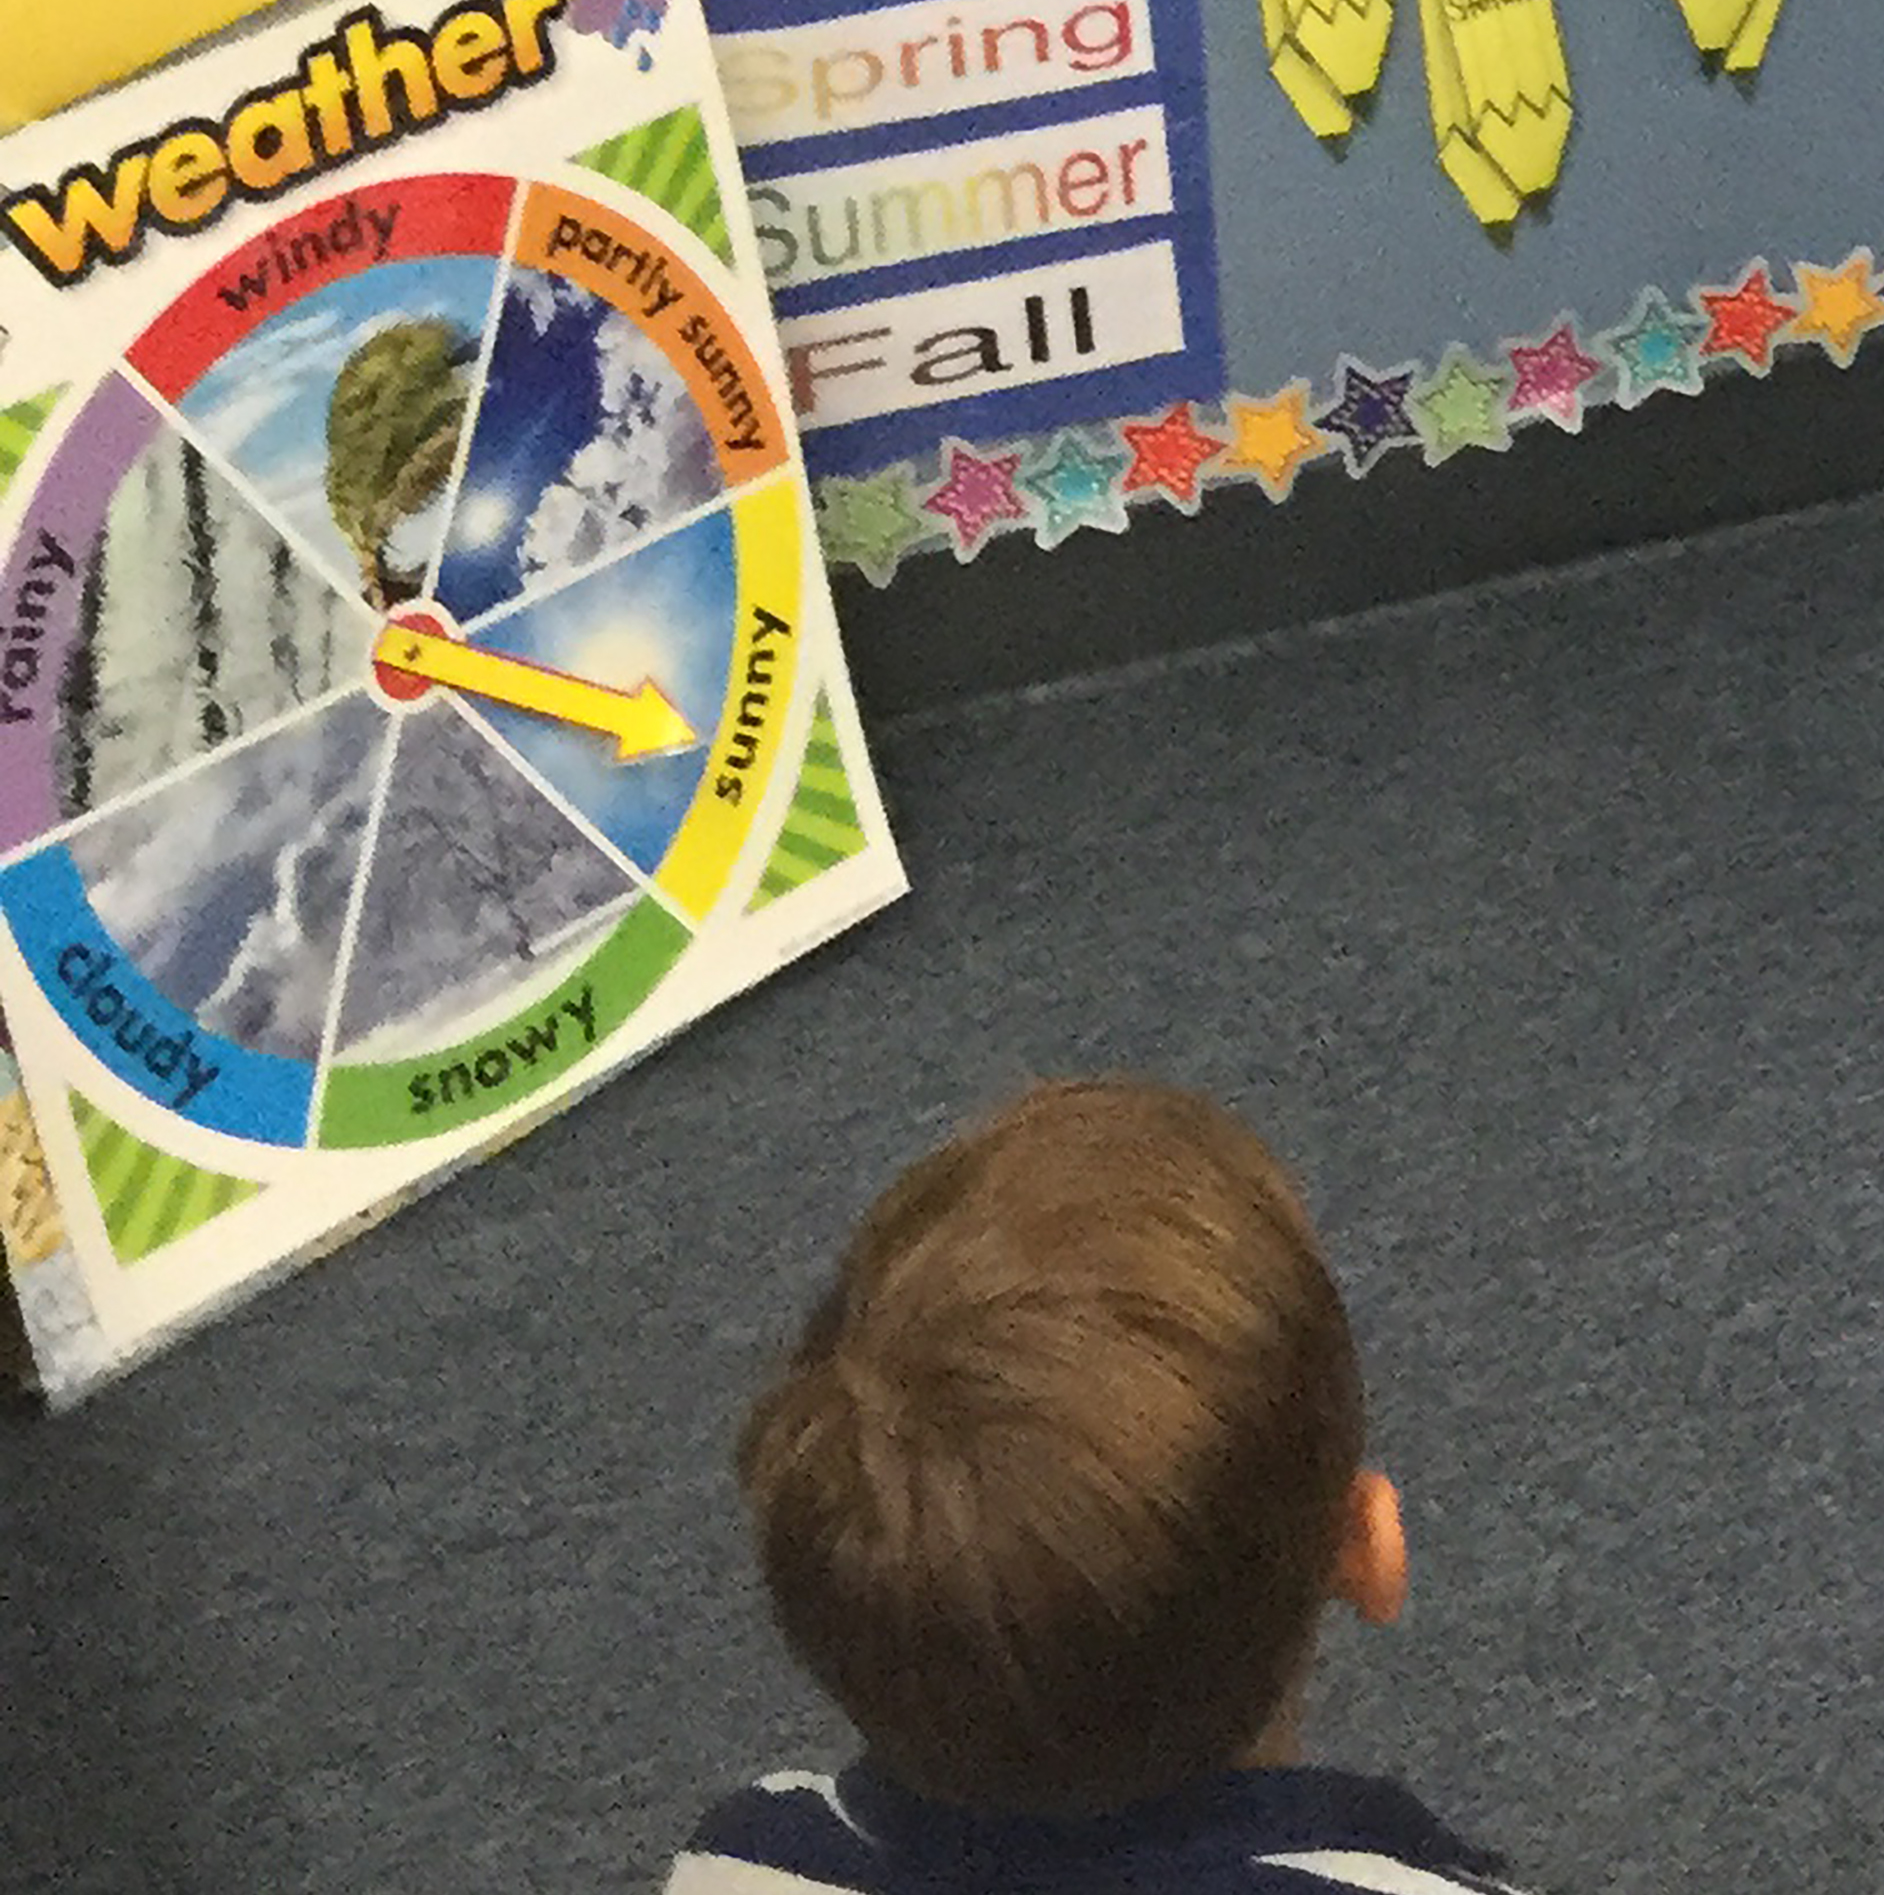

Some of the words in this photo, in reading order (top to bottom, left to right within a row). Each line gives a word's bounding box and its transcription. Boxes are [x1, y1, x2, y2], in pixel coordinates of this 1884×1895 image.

[718, 0, 1134, 122] Spring
[216, 195, 400, 314] windy
[744, 138, 1148, 279] Summer
[547, 211, 684, 321] partly
[678, 311, 766, 457] sunny
[783, 286, 1096, 416] Fall
[714, 605, 793, 806] sunny
[55, 940, 222, 1111] cloudy
[408, 984, 598, 1114] snowy
